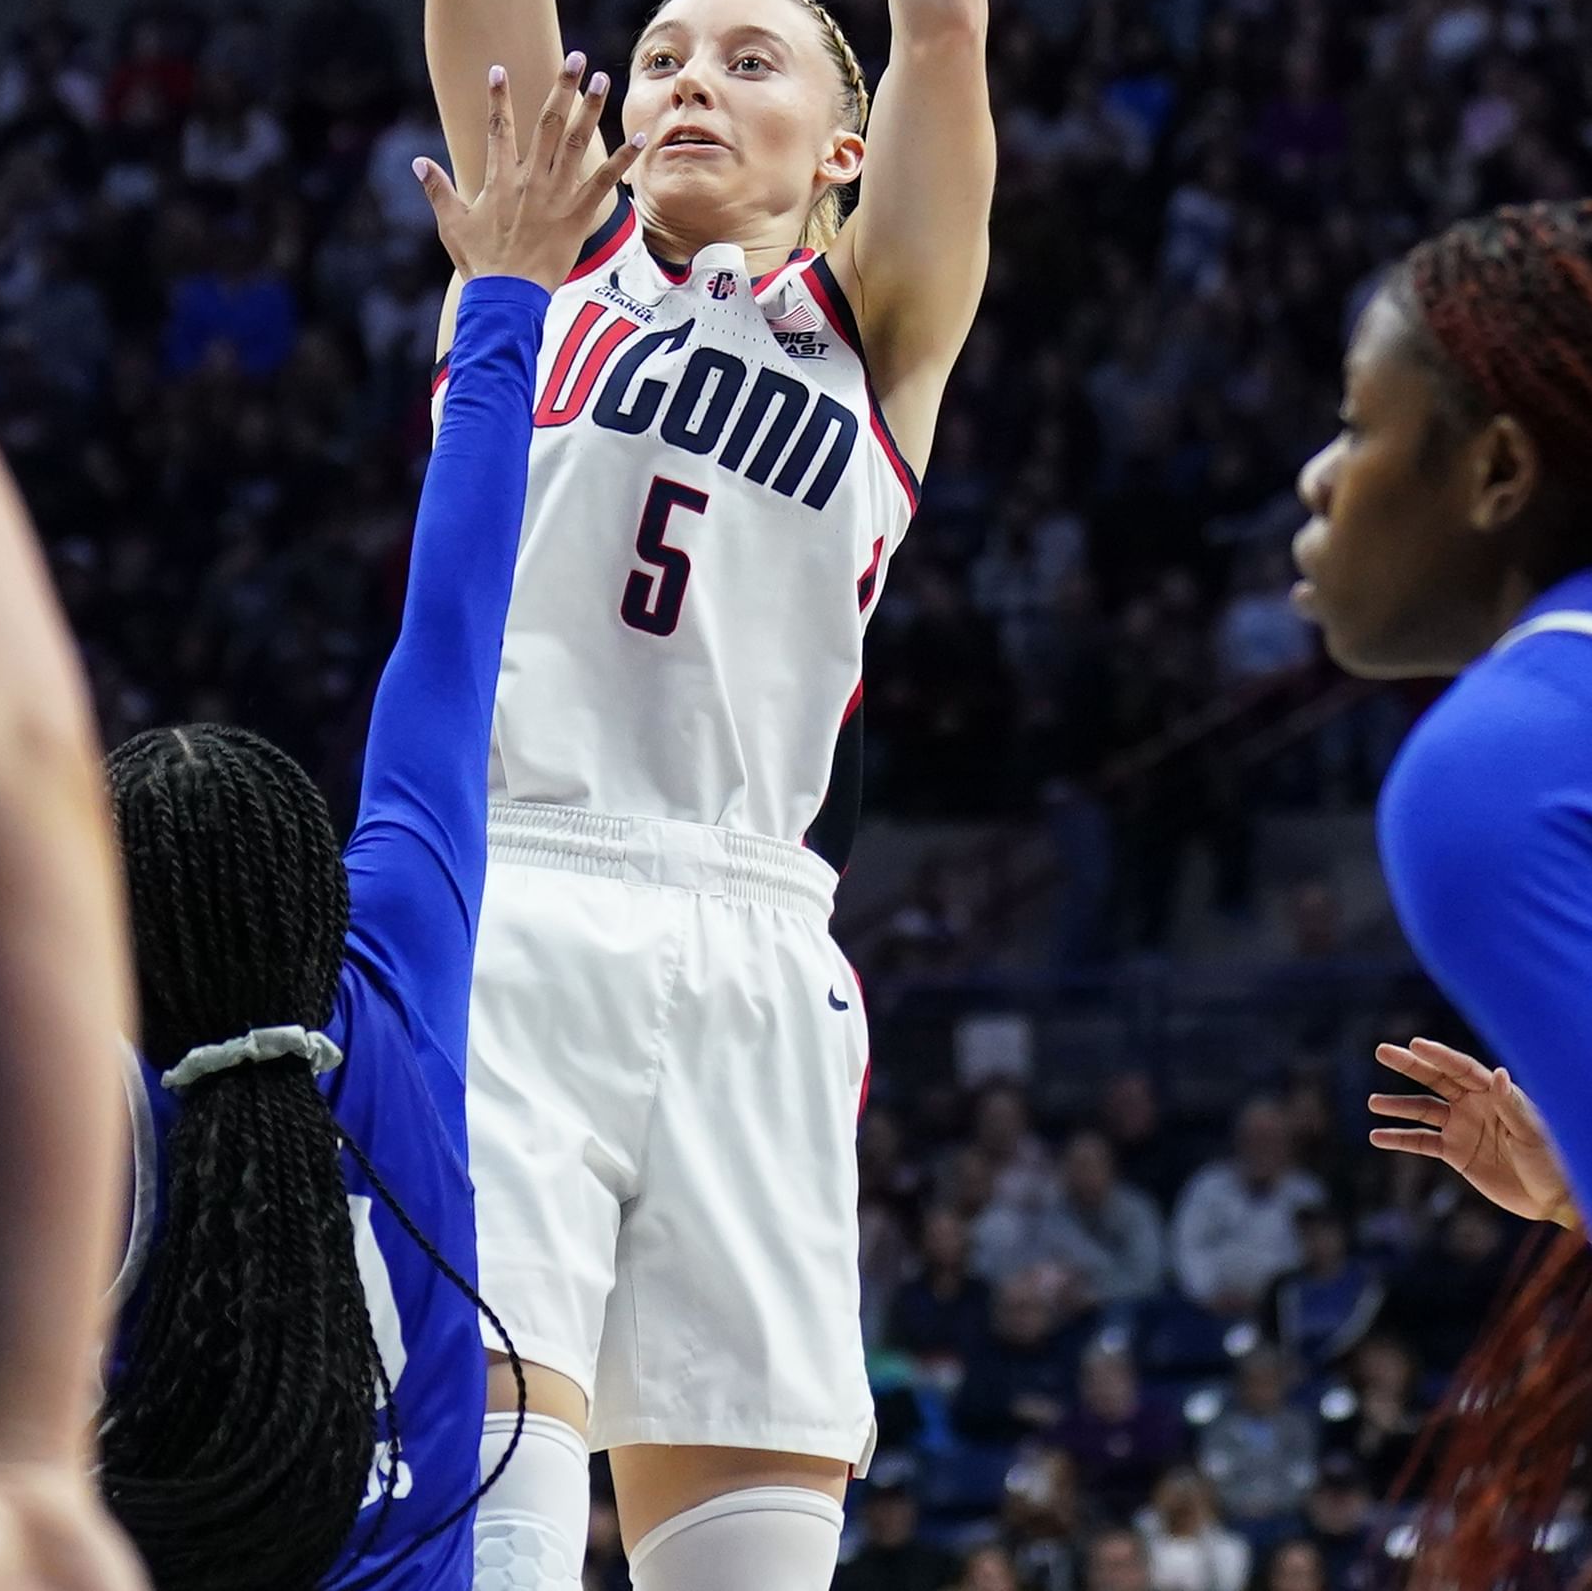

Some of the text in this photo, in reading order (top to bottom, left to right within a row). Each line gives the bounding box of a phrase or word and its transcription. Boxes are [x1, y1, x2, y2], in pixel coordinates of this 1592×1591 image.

[595, 286, 657, 325] CHANGE
[783, 343, 829, 356] AST
[620, 474, 709, 638] 5
